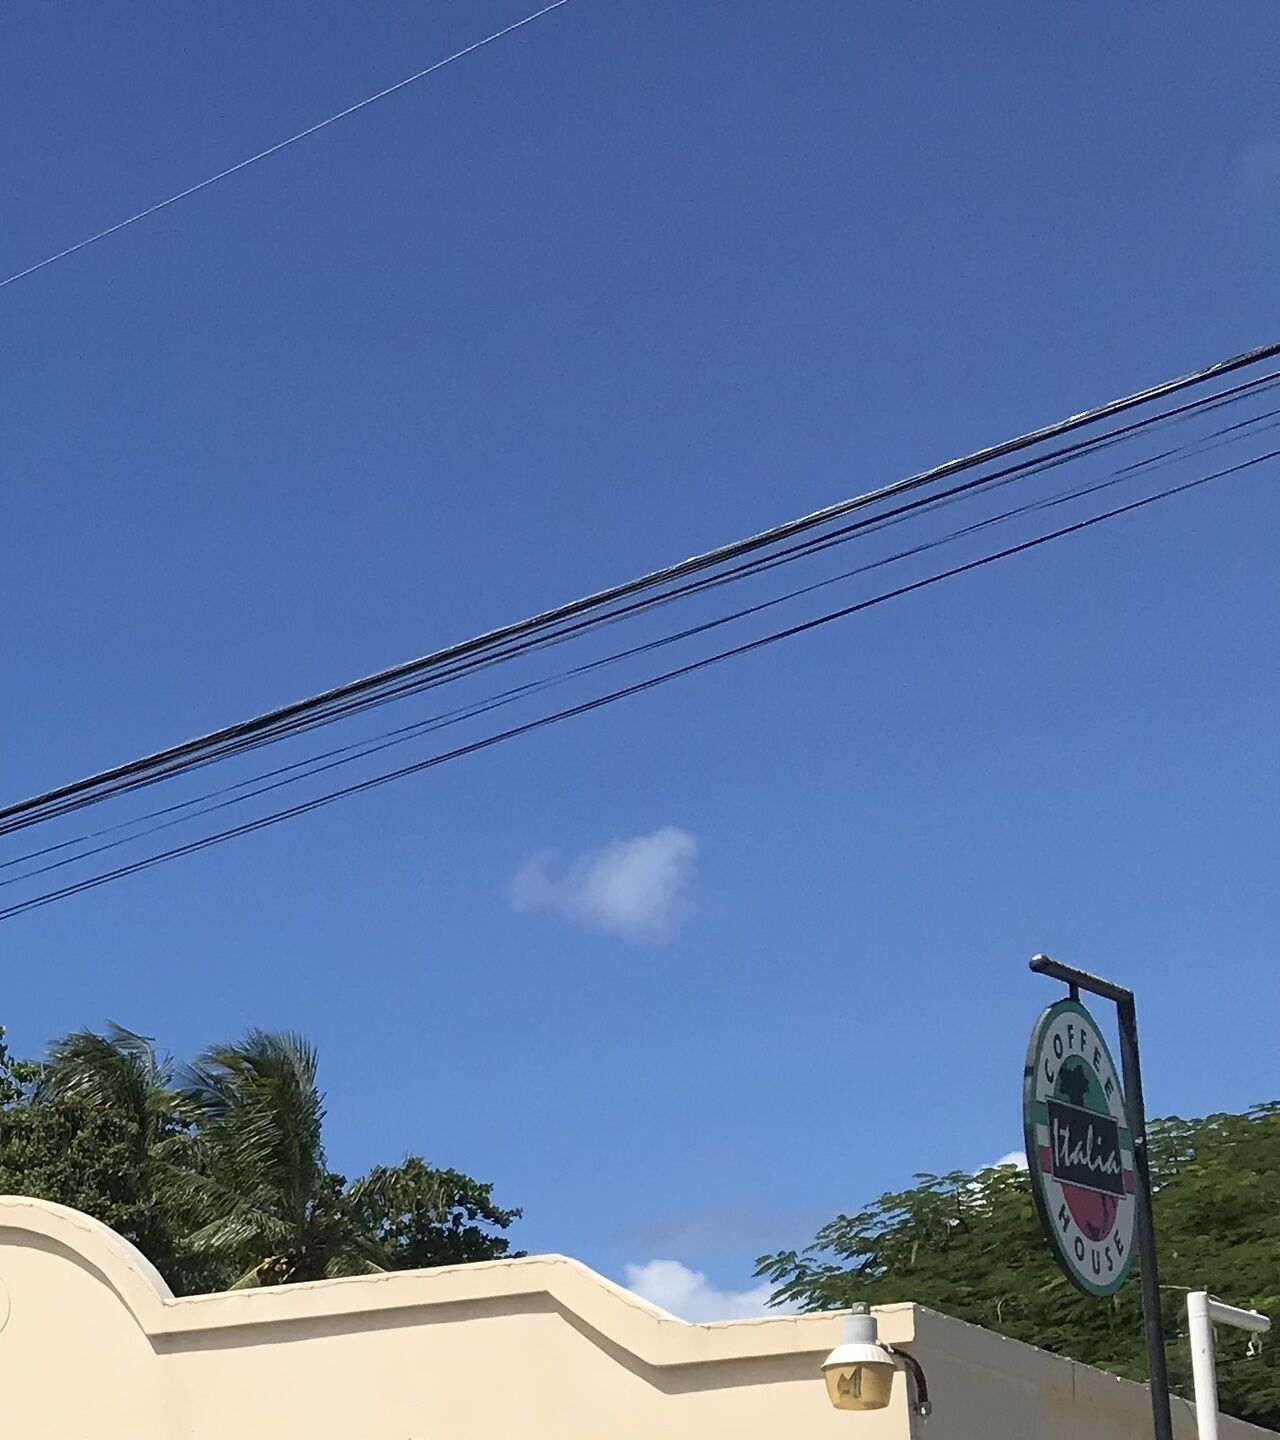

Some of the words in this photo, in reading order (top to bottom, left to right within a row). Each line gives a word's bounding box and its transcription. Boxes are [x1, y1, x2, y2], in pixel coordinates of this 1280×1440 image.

[1044, 1023, 1114, 1102] COFFEE
[1052, 1117, 1121, 1175] Italia
[1057, 1203, 1124, 1276] HOUSE
